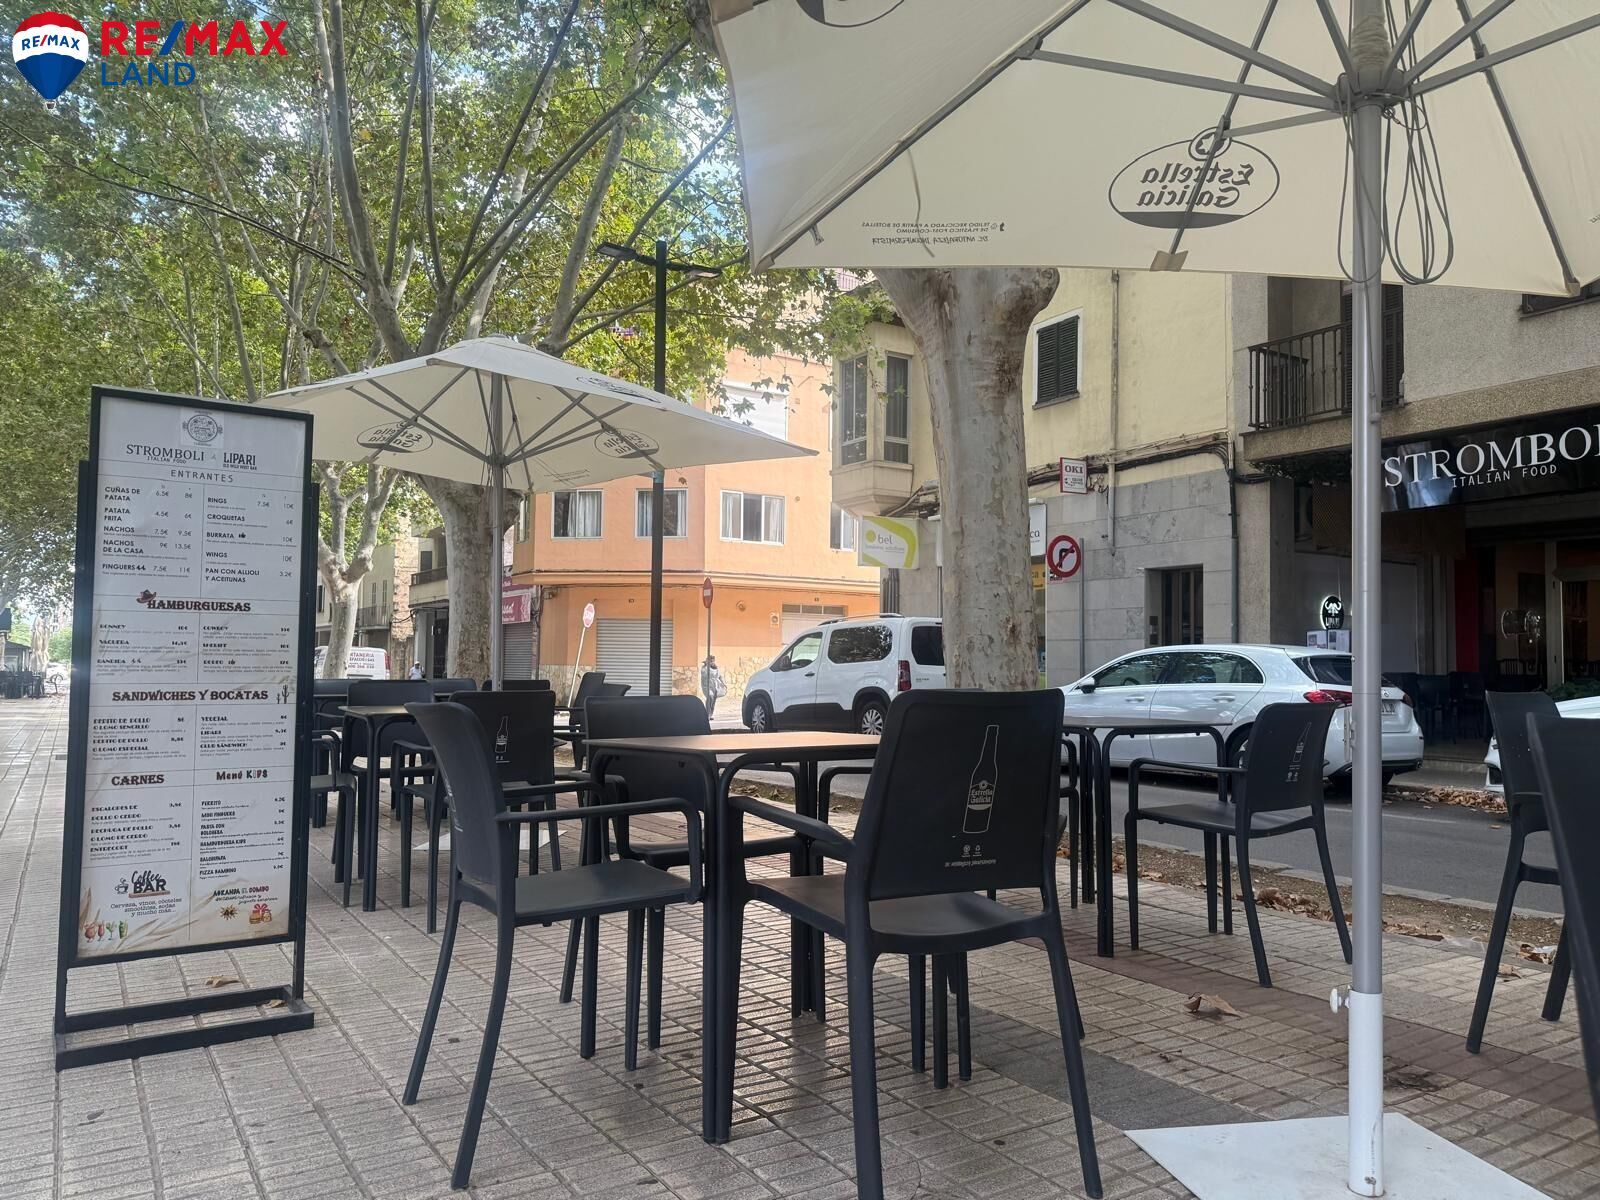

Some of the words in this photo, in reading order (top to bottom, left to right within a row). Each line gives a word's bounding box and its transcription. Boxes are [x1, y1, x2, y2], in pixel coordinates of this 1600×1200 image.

[126, 444, 204, 461] STROMBOLI
[224, 452, 256, 465] LIPARI
[171, 469, 233, 482] ENTRANTES
[1064, 464, 1084, 474] OKI
[1452, 470, 1511, 488] ITALIAN
[1522, 464, 1557, 478] FOOD
[878, 534, 892, 544] bel
[148, 599, 251, 612] HAMBURGUESAS
[112, 690, 197, 701] SANDWICHES
[199, 689, 208, 700] Y
[211, 690, 268, 700] BOCATAS
[111, 774, 165, 786] CARNES
[216, 771, 242, 781] Menú
[131, 870, 161, 885] Coffee
[134, 879, 166, 894] BAR
